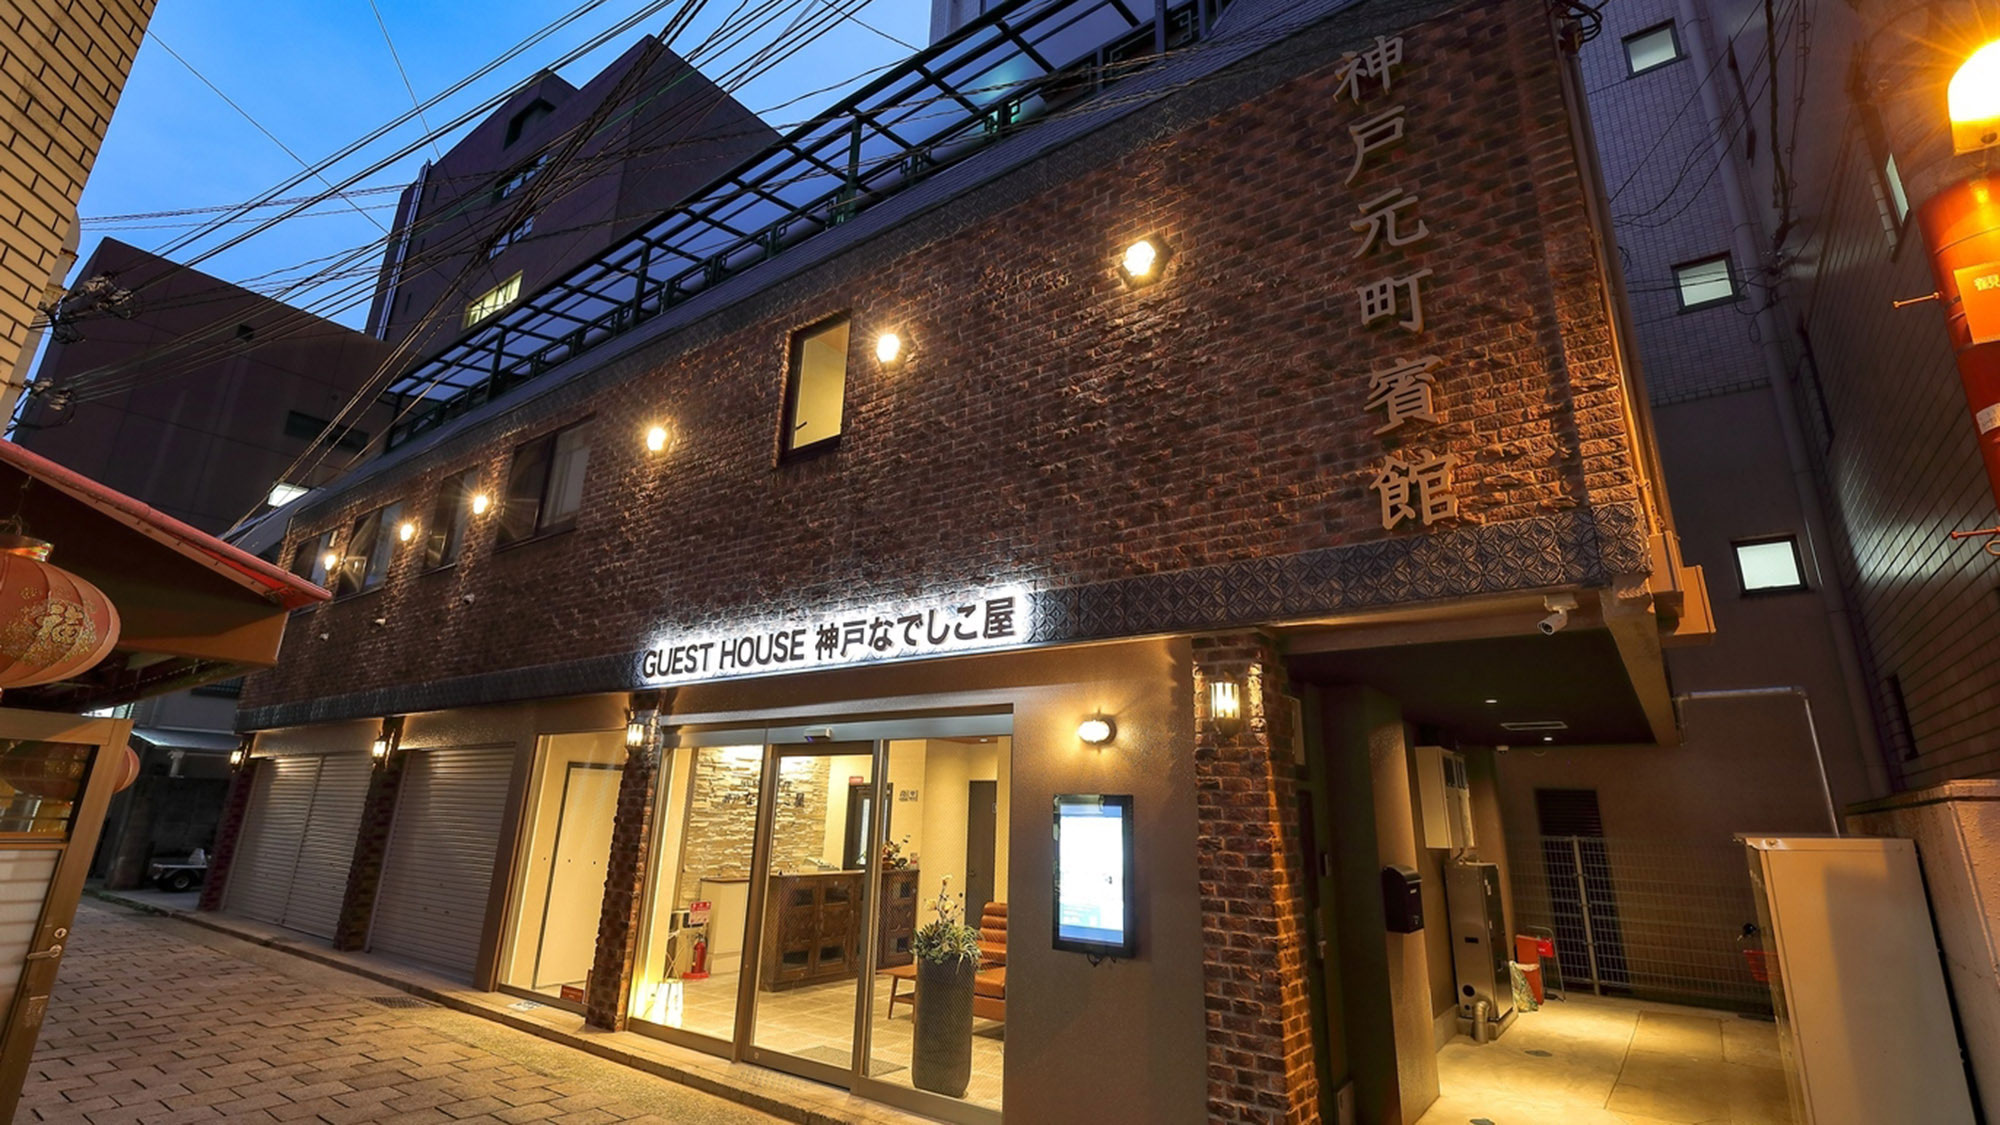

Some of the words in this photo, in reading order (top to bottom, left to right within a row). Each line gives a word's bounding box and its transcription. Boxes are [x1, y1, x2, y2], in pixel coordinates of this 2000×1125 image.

[1333, 35, 1459, 530] 神戸元町賓館
[642, 642, 715, 679] GUEST
[719, 628, 807, 670] HOUSE
[815, 596, 1016, 660] 神戸なでしこ屋
